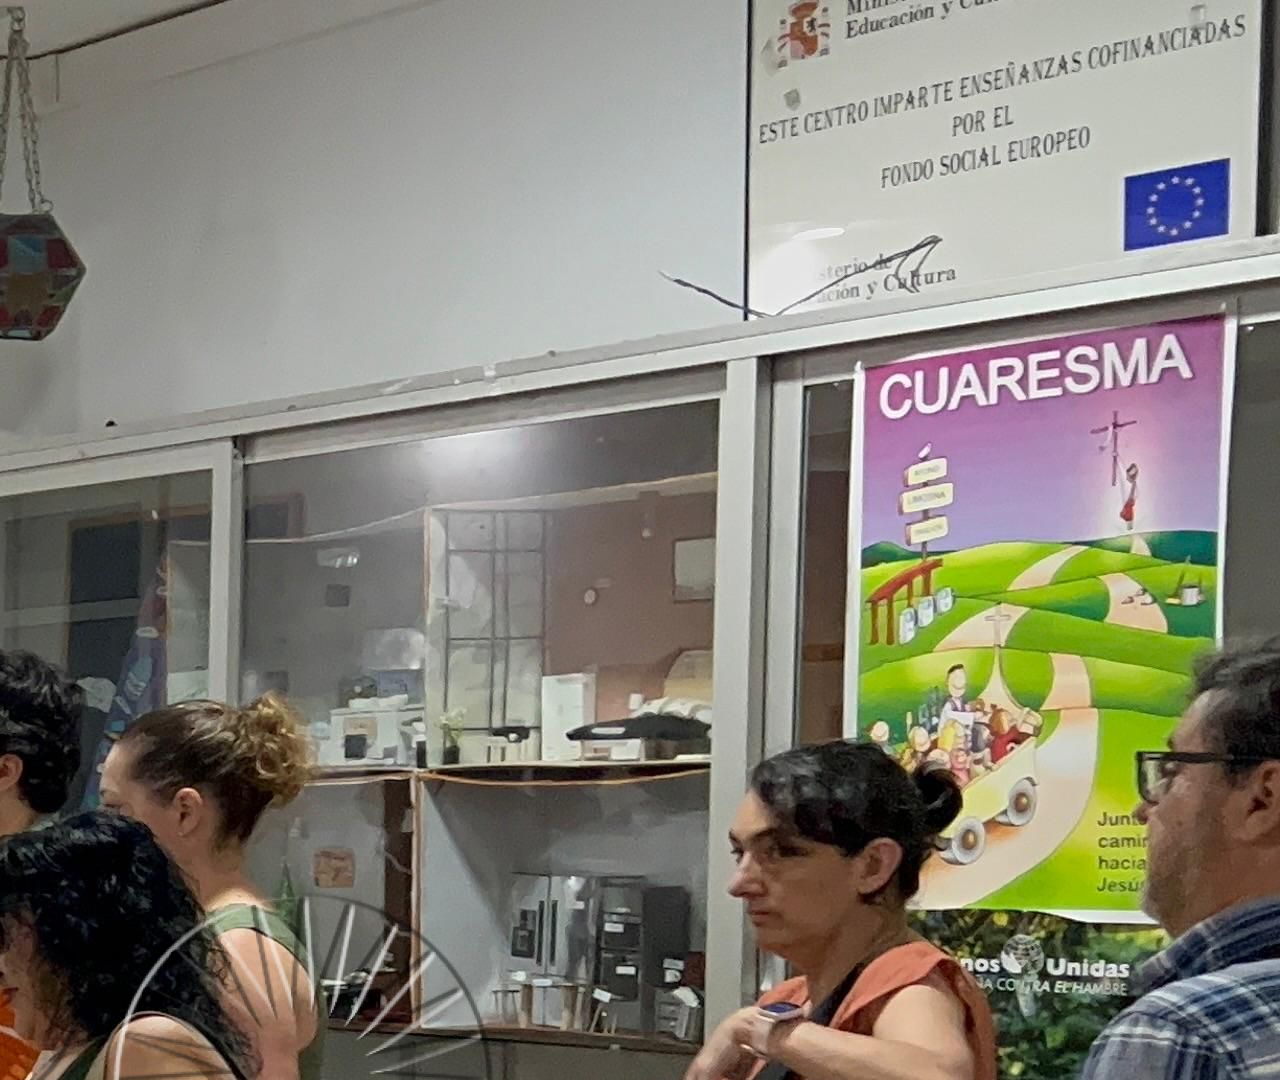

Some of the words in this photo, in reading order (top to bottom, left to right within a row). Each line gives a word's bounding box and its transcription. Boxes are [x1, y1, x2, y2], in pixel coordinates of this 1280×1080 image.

[846, 5, 934, 39] Educación
[940, 1, 953, 20] y
[759, 116, 800, 144] ESTE
[804, 104, 869, 136] CENTRO
[873, 80, 954, 119] IMPARTE
[959, 51, 1083, 101] ENSEÑANZAS
[1087, 14, 1247, 71] COFINANCIADAS
[952, 111, 987, 137] POR
[992, 105, 1015, 129] EL
[880, 158, 935, 189] FONDO
[939, 144, 1002, 178] SOCIAL
[1007, 125, 1091, 163] EUROPEO
[883, 268, 957, 293] Cultura
[879, 333, 1193, 420] CUARESMA
[1098, 855, 1146, 870] hacia
[1097, 877, 1144, 892] Jesú
[960, 957, 1001, 974] nos
[1046, 957, 1131, 978] Unidas
[1071, 981, 1129, 996] HAMBRE
